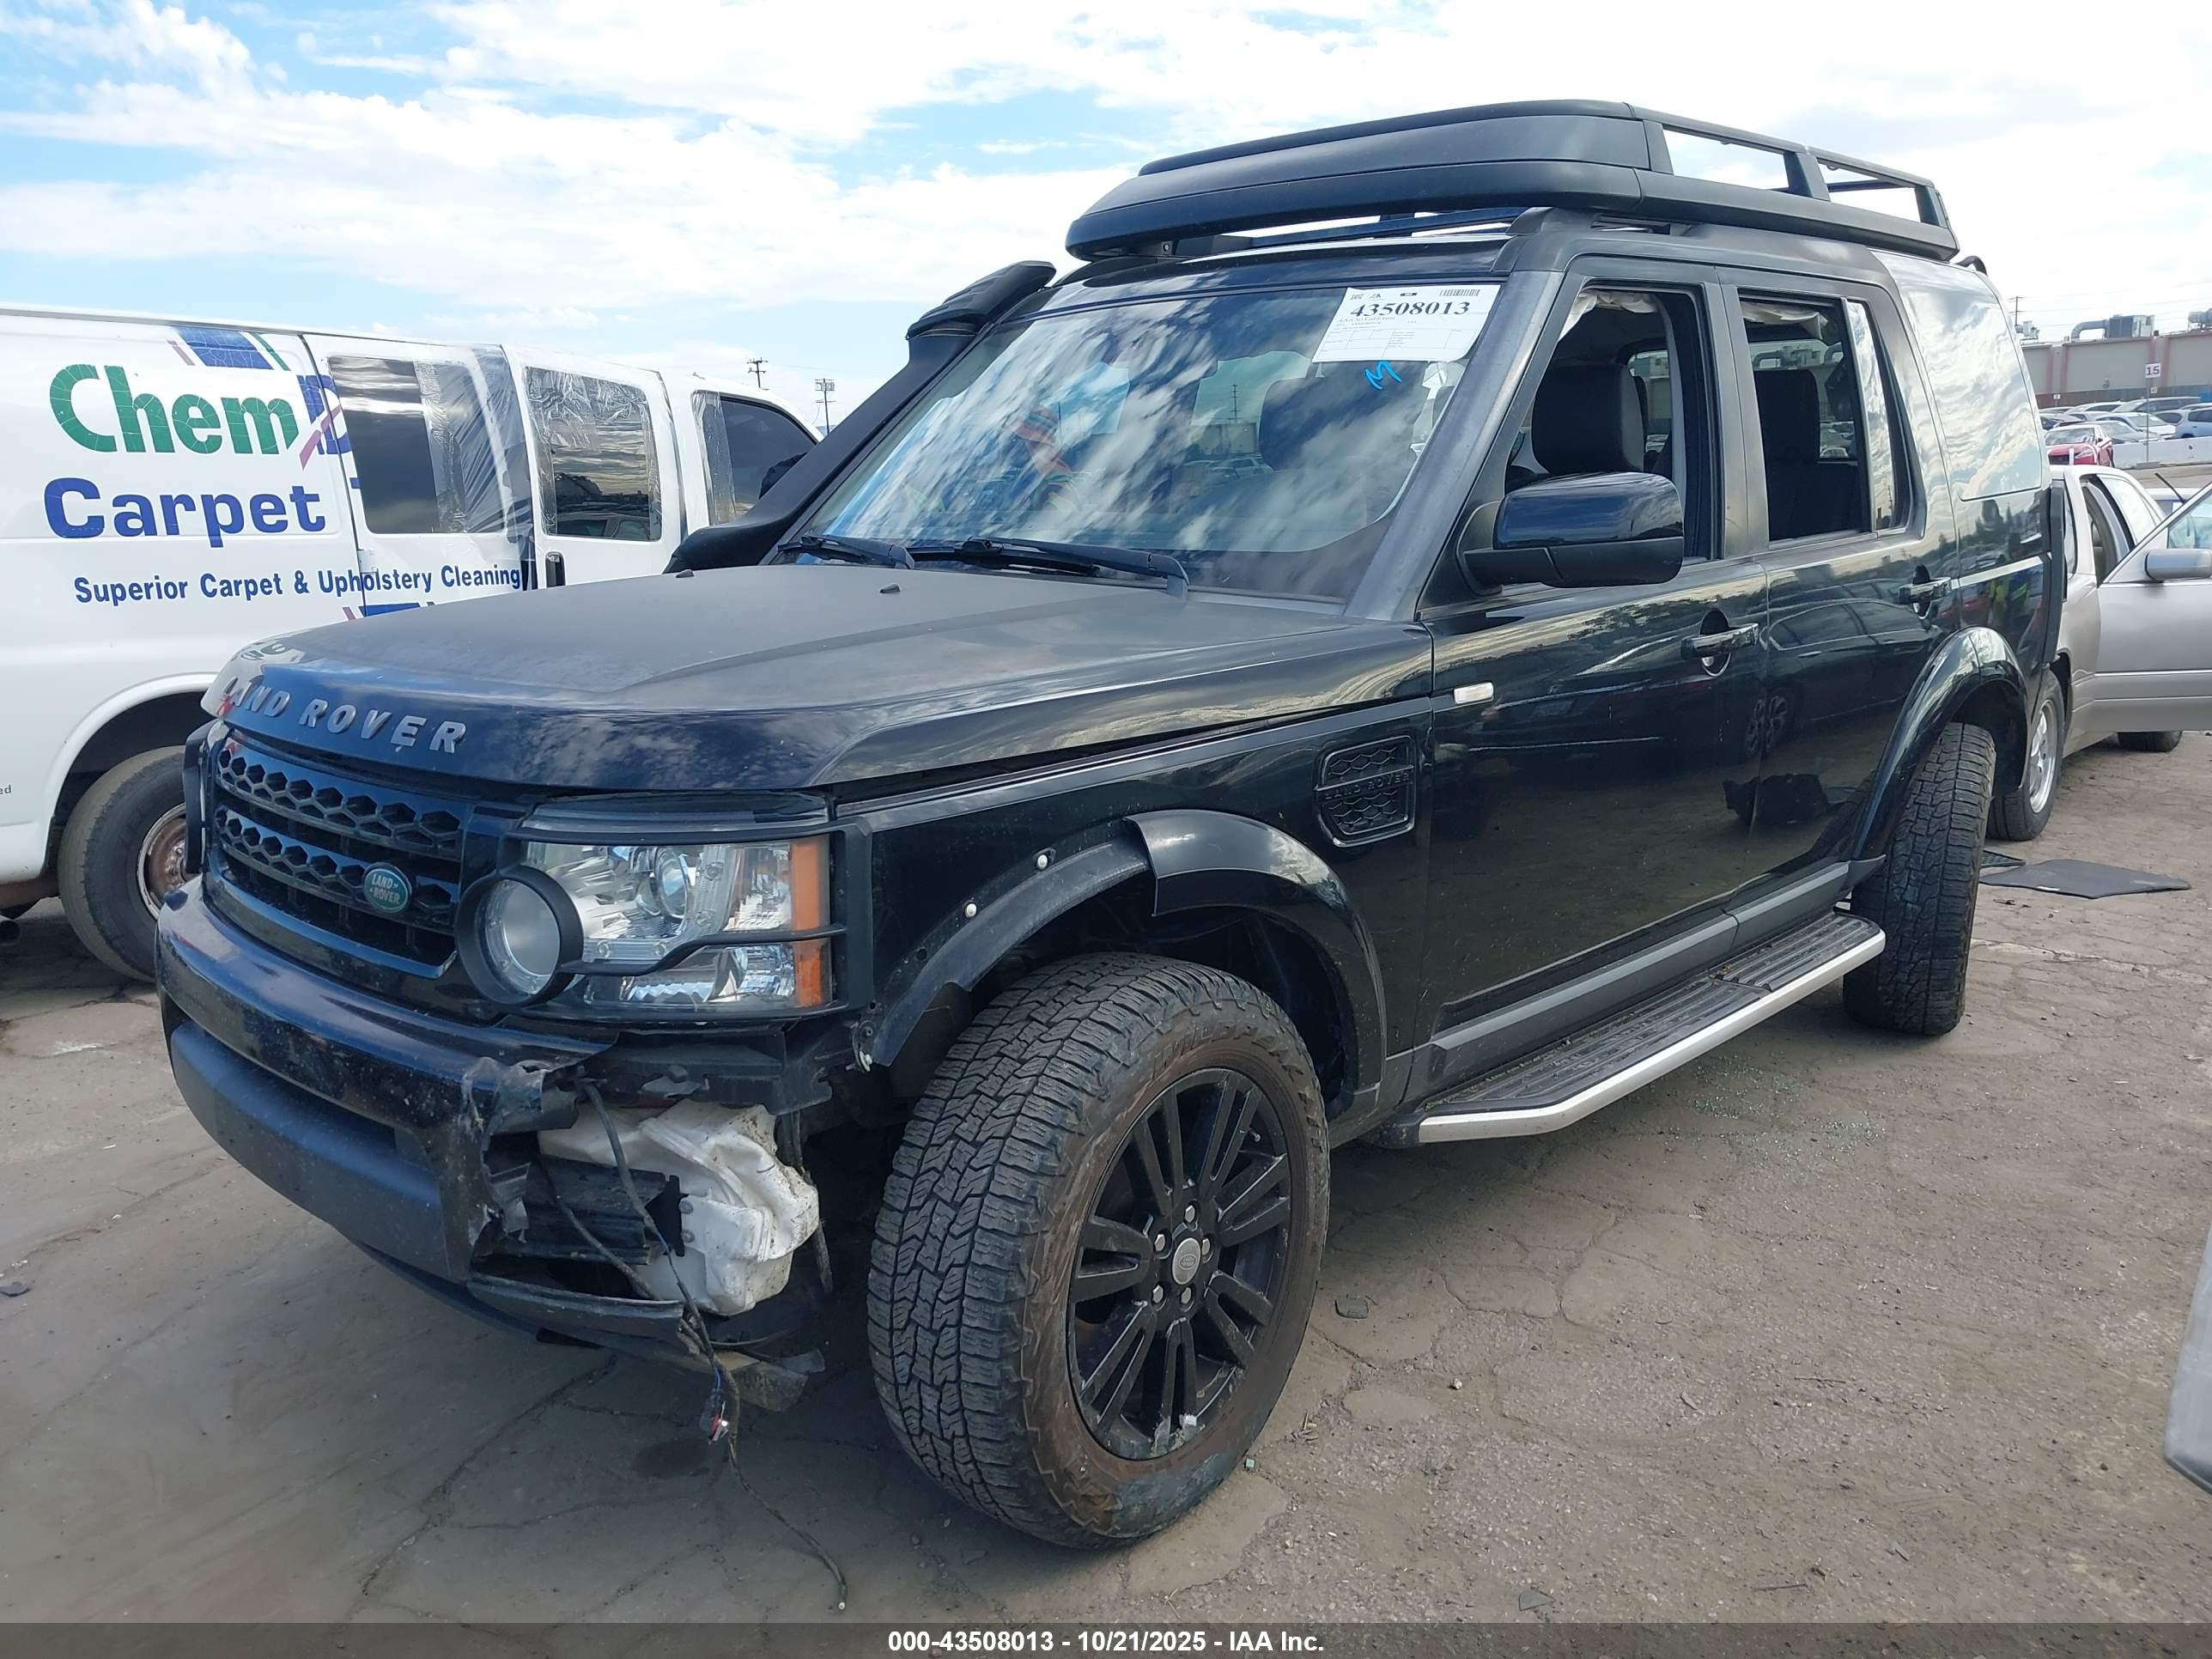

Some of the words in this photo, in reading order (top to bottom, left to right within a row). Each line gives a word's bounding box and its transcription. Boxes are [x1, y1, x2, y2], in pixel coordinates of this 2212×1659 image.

[1349, 301, 1471, 317] 43508013
[2146, 366, 2160, 376] 15
[44, 477, 325, 548] Carpet
[74, 576, 189, 606] Superior
[199, 572, 284, 599] Carpet
[294, 569, 310, 593] &
[318, 568, 432, 596] Upholstery
[441, 564, 521, 590] Cleaning
[222, 677, 291, 718] LAND
[298, 698, 467, 754] ROVER
[371, 873, 394, 890] LAND
[373, 887, 400, 904] ROVER
